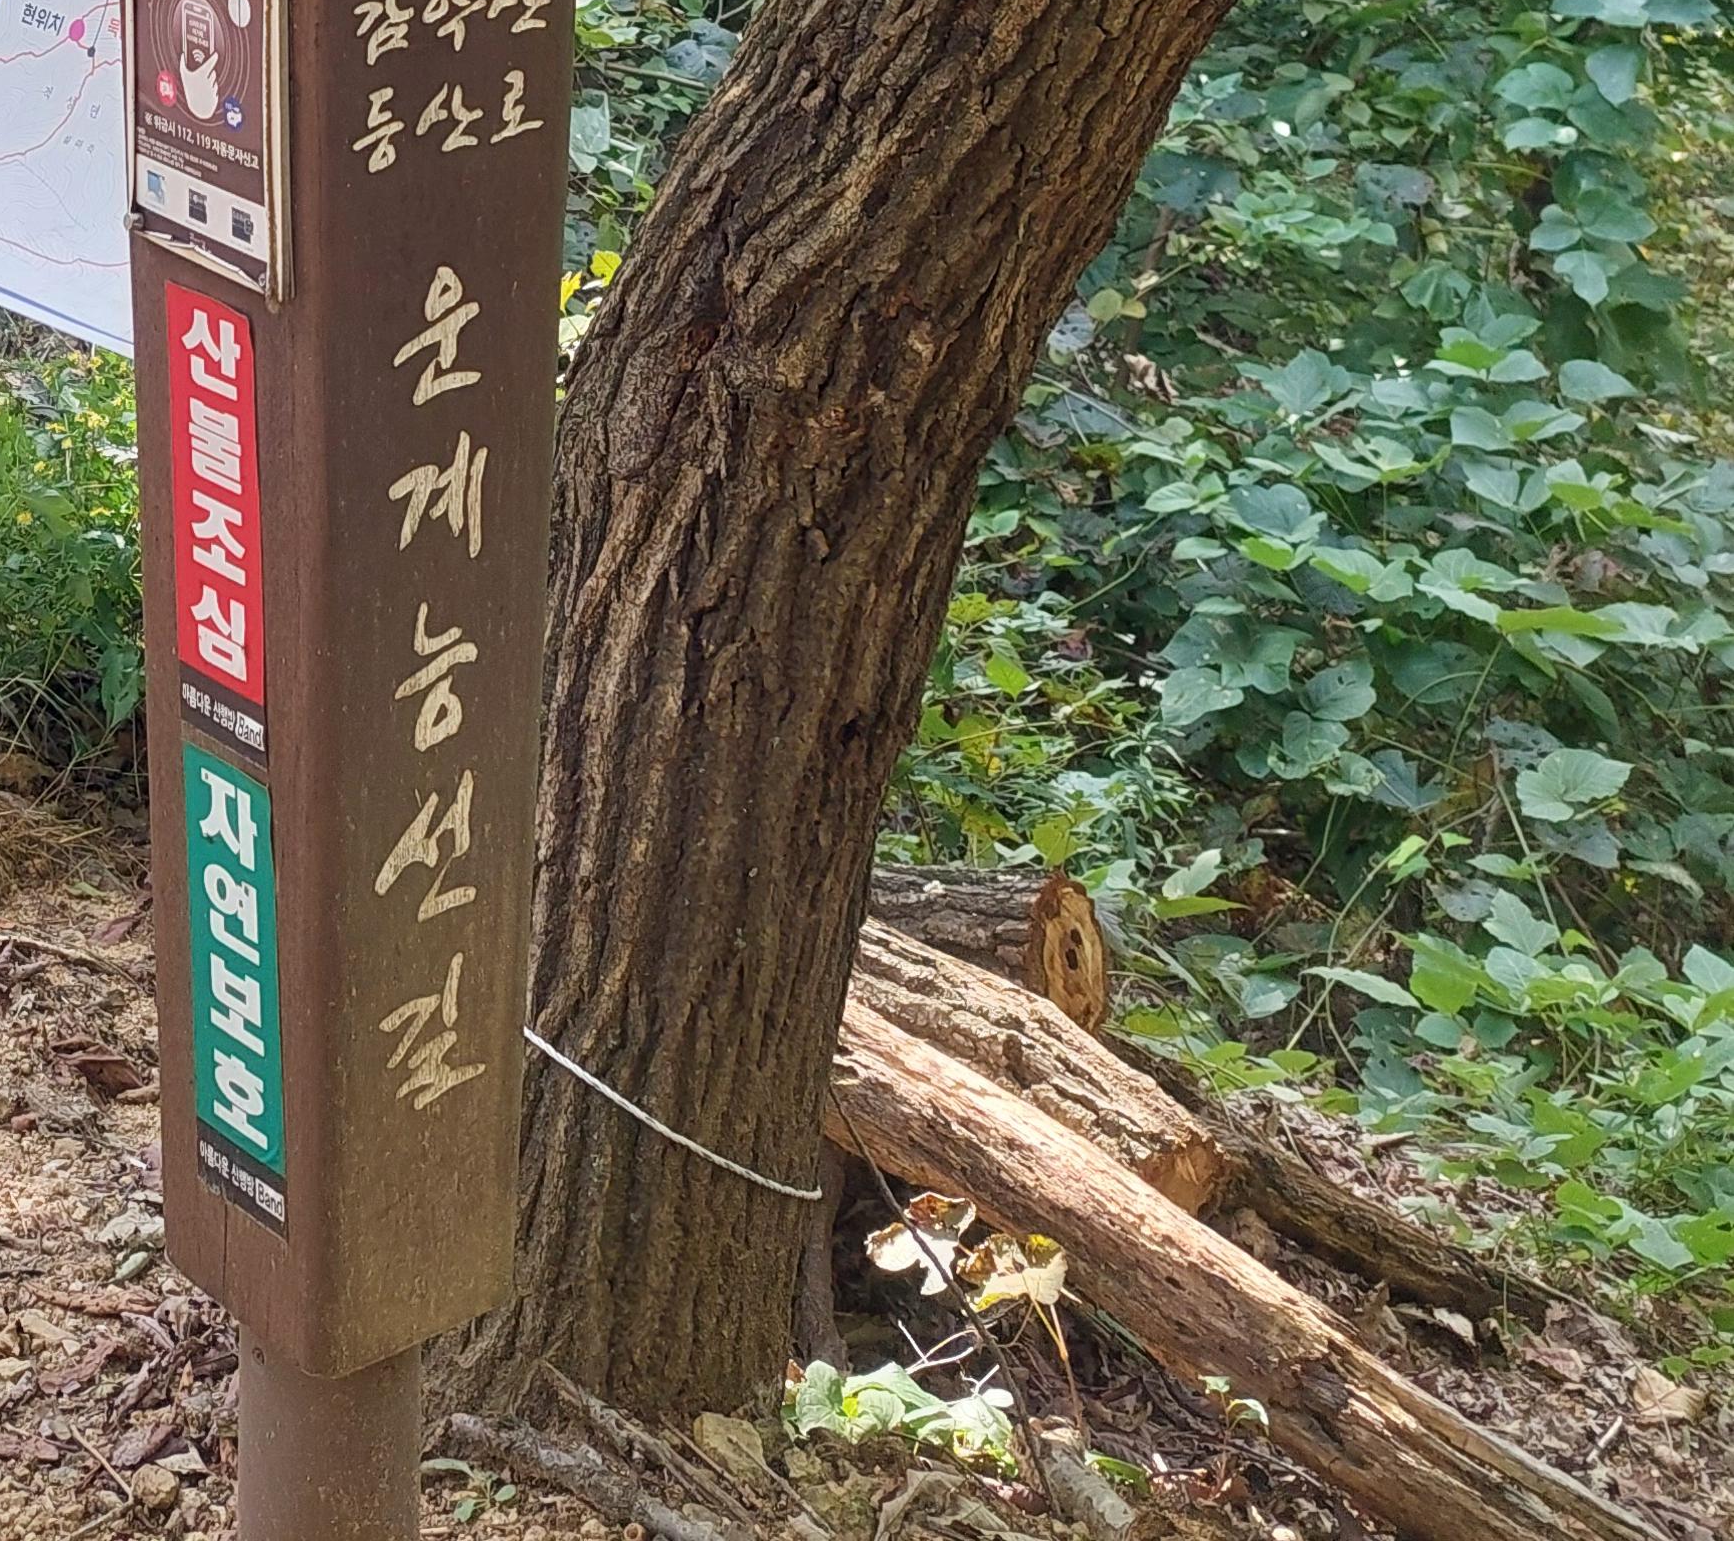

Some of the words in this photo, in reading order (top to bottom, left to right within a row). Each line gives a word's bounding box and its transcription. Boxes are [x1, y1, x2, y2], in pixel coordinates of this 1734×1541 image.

[22, 2, 65, 37] 현위치
[196, 132, 211, 150] 119
[352, 69, 545, 173] 등산로
[180, 308, 248, 683] 산불조심
[182, 682, 212, 717] 아름다운
[237, 715, 262, 746] Band
[199, 767, 269, 1151] 자연보호
[199, 1140, 230, 1179] 아름다운
[257, 1182, 284, 1217] Band
